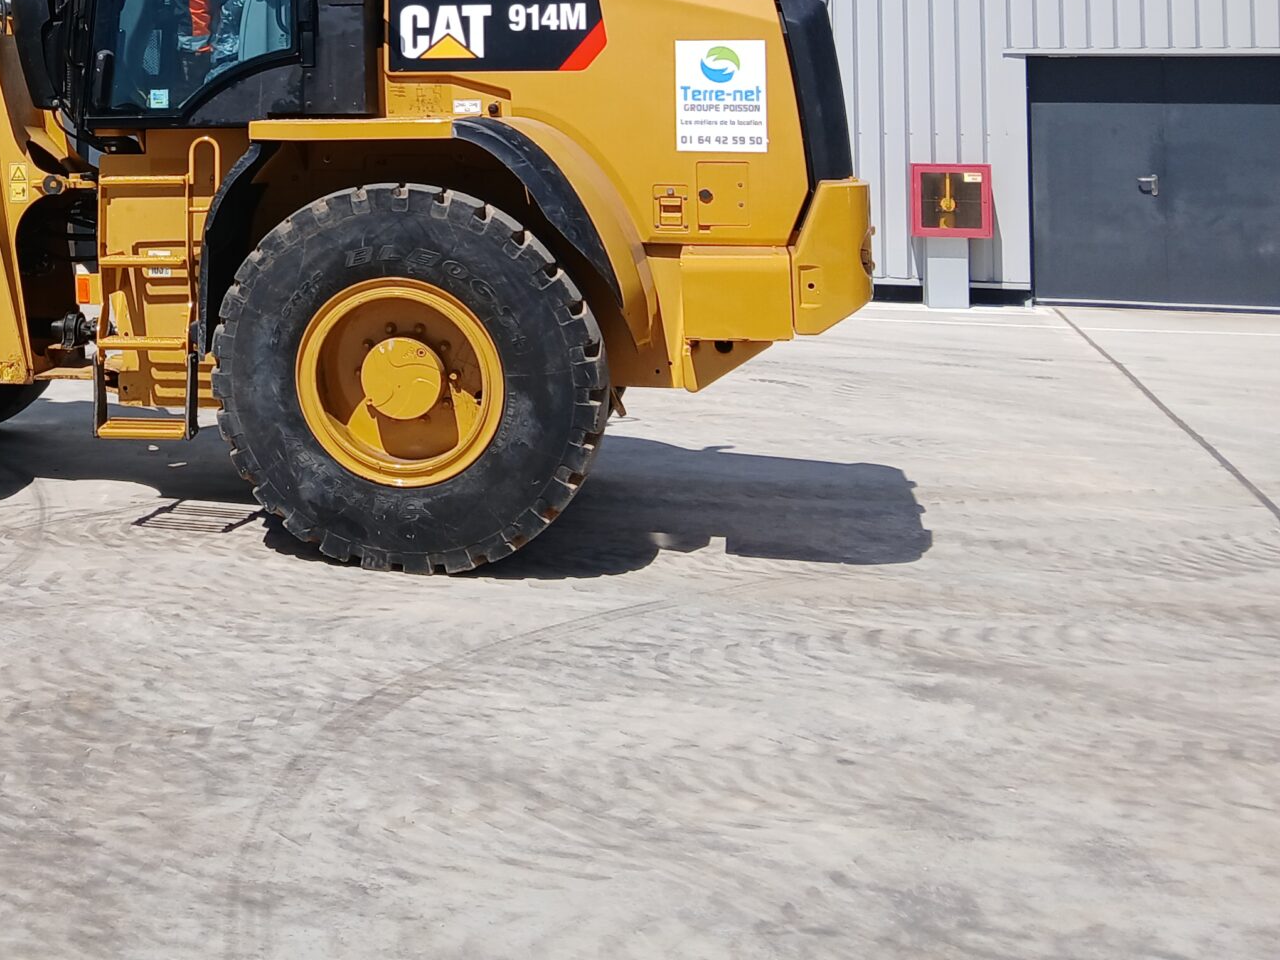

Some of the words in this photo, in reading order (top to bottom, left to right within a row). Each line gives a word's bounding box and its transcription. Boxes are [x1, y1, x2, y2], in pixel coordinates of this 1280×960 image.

[399, 4, 492, 59] CAT
[508, 3, 587, 31] 914M
[680, 85, 762, 102] Terre-net
[683, 104, 720, 112] GROUPE
[723, 104, 761, 112] POISSON
[680, 135, 693, 144] 01
[697, 135, 711, 144] 64
[714, 136, 728, 145] 42
[732, 136, 746, 145] 59
[749, 136, 763, 145] 50
